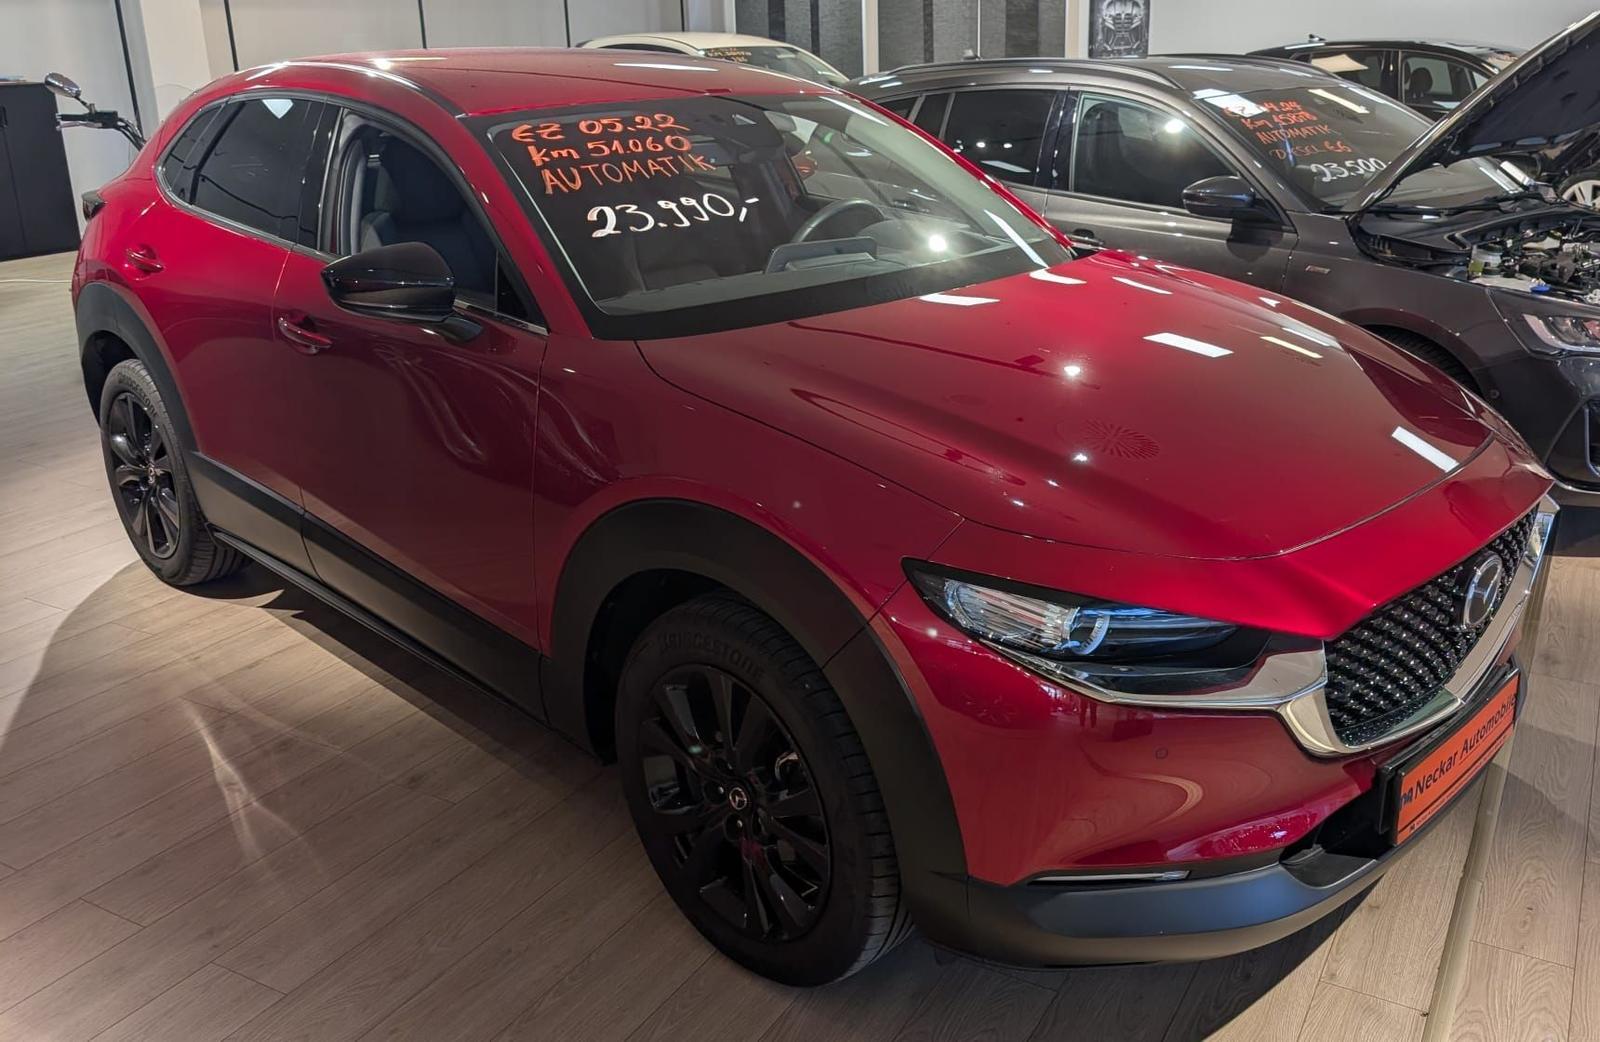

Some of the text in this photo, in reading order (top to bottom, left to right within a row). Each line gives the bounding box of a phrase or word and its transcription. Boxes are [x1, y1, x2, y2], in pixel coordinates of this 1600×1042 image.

[578, 113, 690, 134] 05.22
[1256, 124, 1331, 145] AUTOMATIK
[587, 135, 693, 157] 51.060
[1269, 144, 1319, 160] DESEL
[541, 154, 716, 195] AUTOMATIK
[1414, 753, 1457, 800] Neckar
